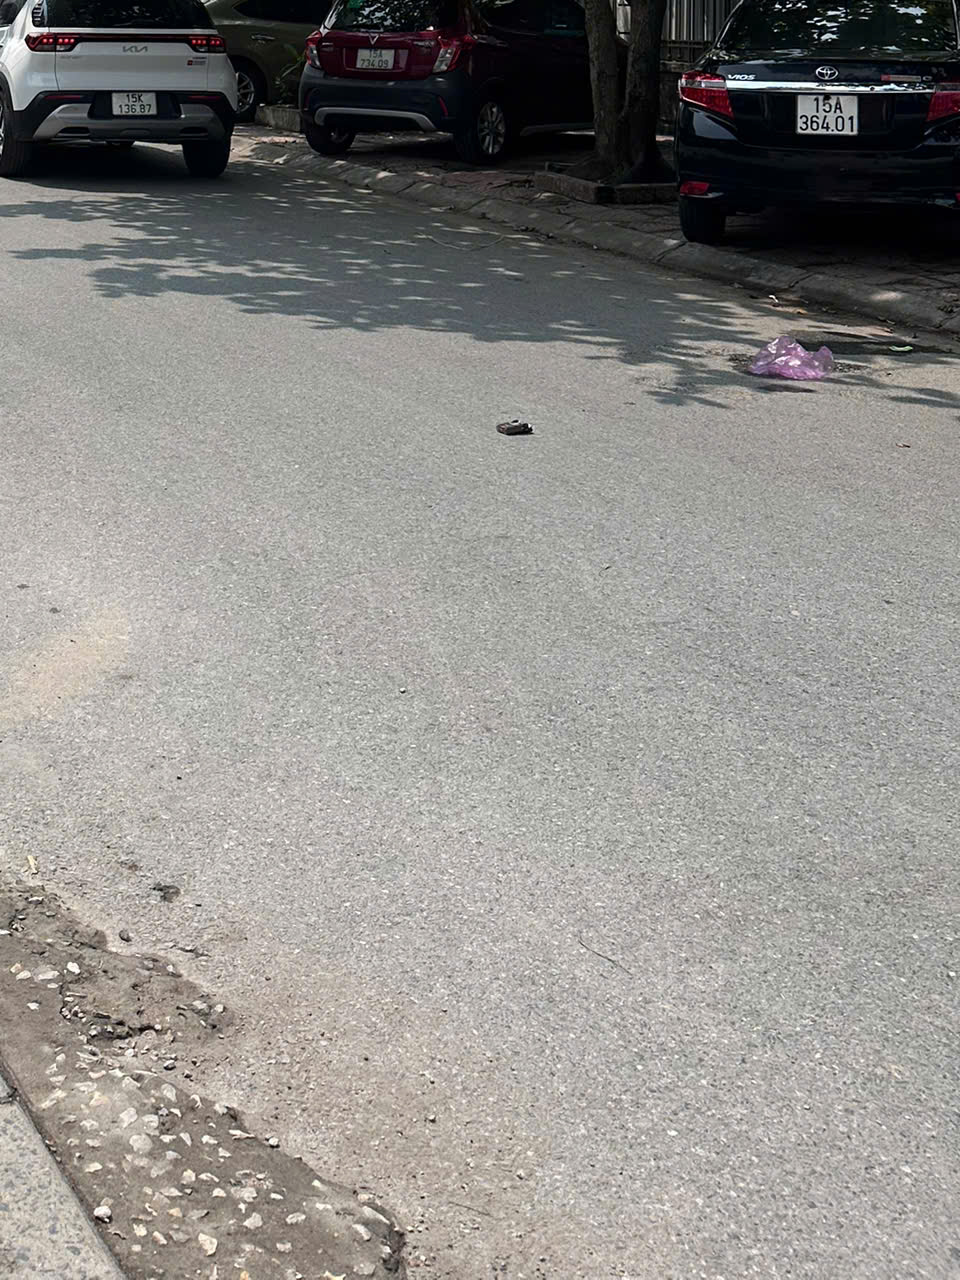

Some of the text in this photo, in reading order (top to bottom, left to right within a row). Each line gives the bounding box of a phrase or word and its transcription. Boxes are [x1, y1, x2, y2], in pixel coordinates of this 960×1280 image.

[126, 93, 144, 103] 15K
[813, 96, 843, 114] 15A
[119, 104, 152, 114] 136.87
[799, 114, 855, 133] 364.01
